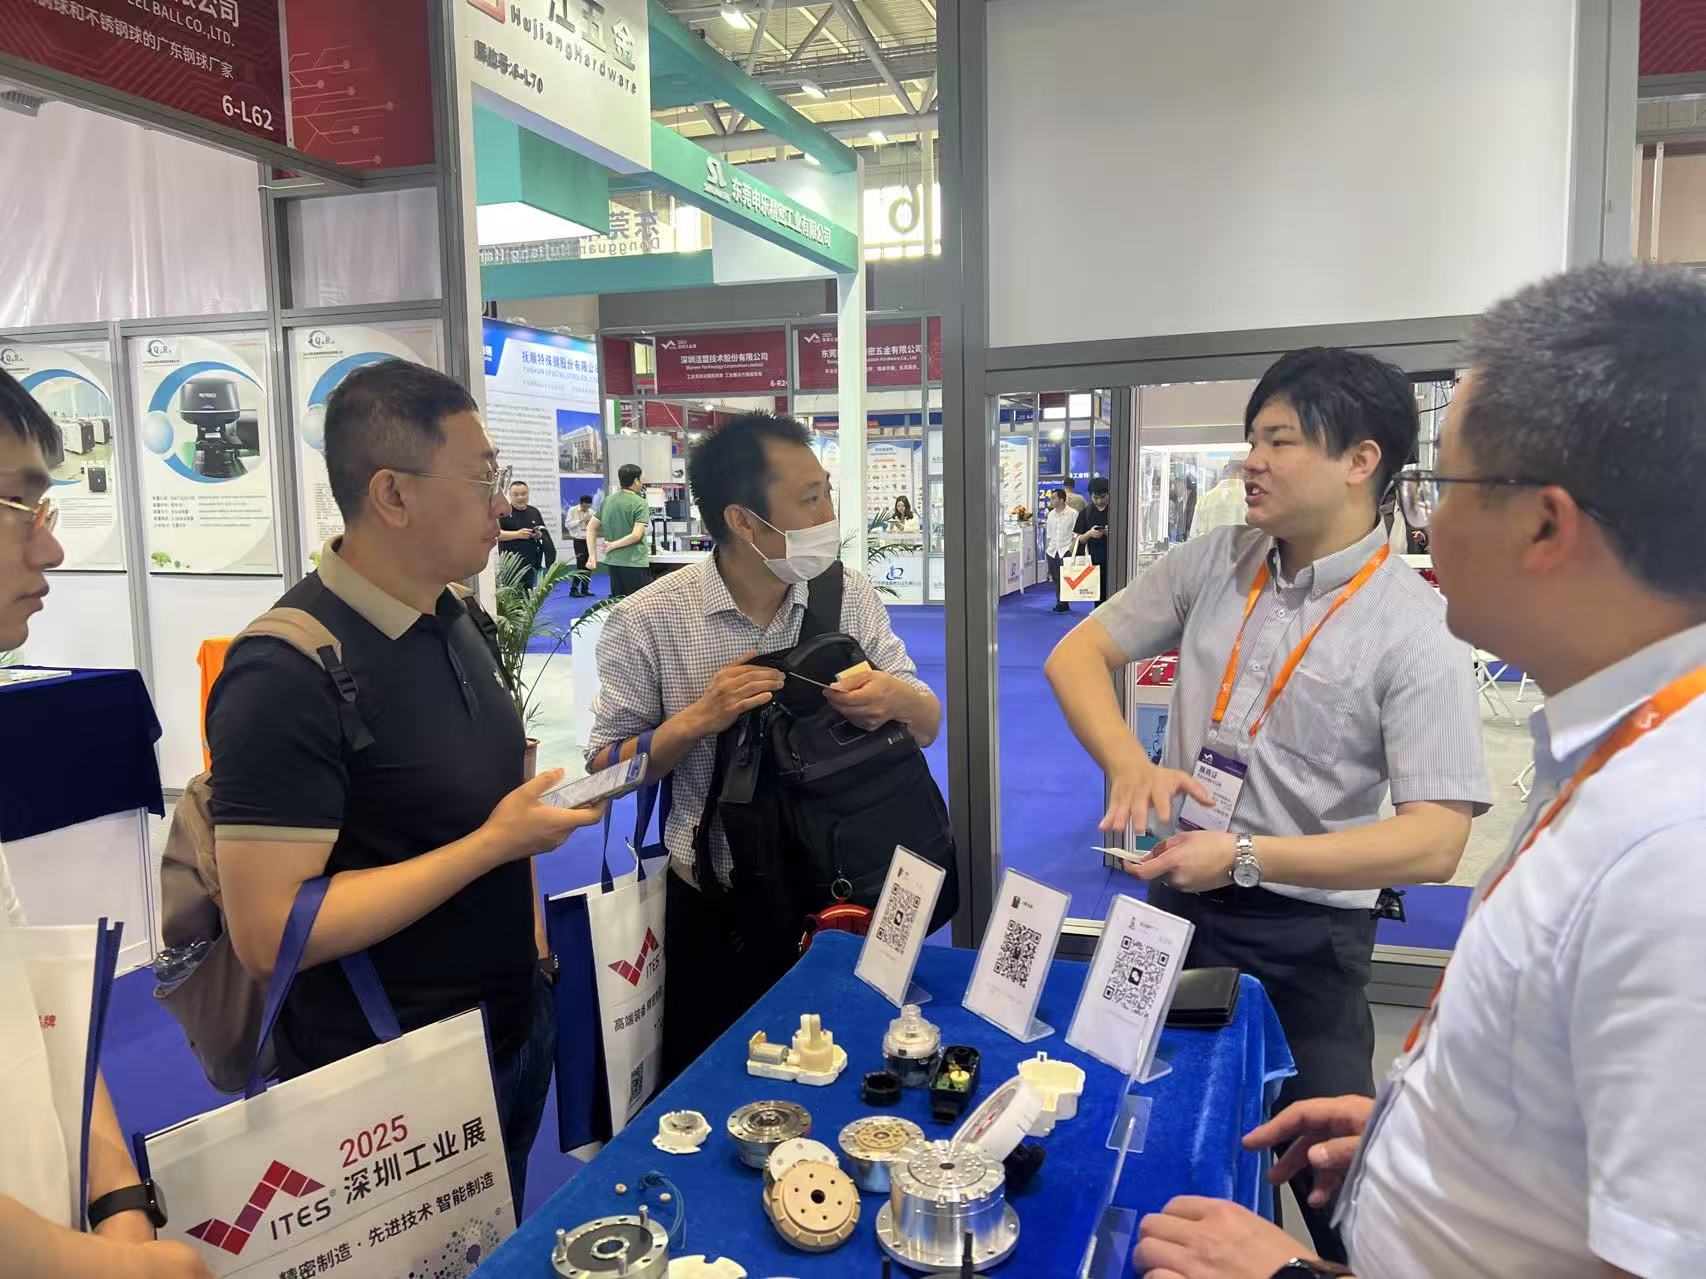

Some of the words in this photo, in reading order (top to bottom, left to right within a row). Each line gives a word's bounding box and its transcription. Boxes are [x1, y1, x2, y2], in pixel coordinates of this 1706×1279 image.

[152, 1, 184, 26] BALL
[222, 95, 274, 132] 6-L62
[339, 1114, 409, 1169] 2025
[343, 1116, 487, 1205] 深圳工业展
[271, 1197, 332, 1241] ITES
